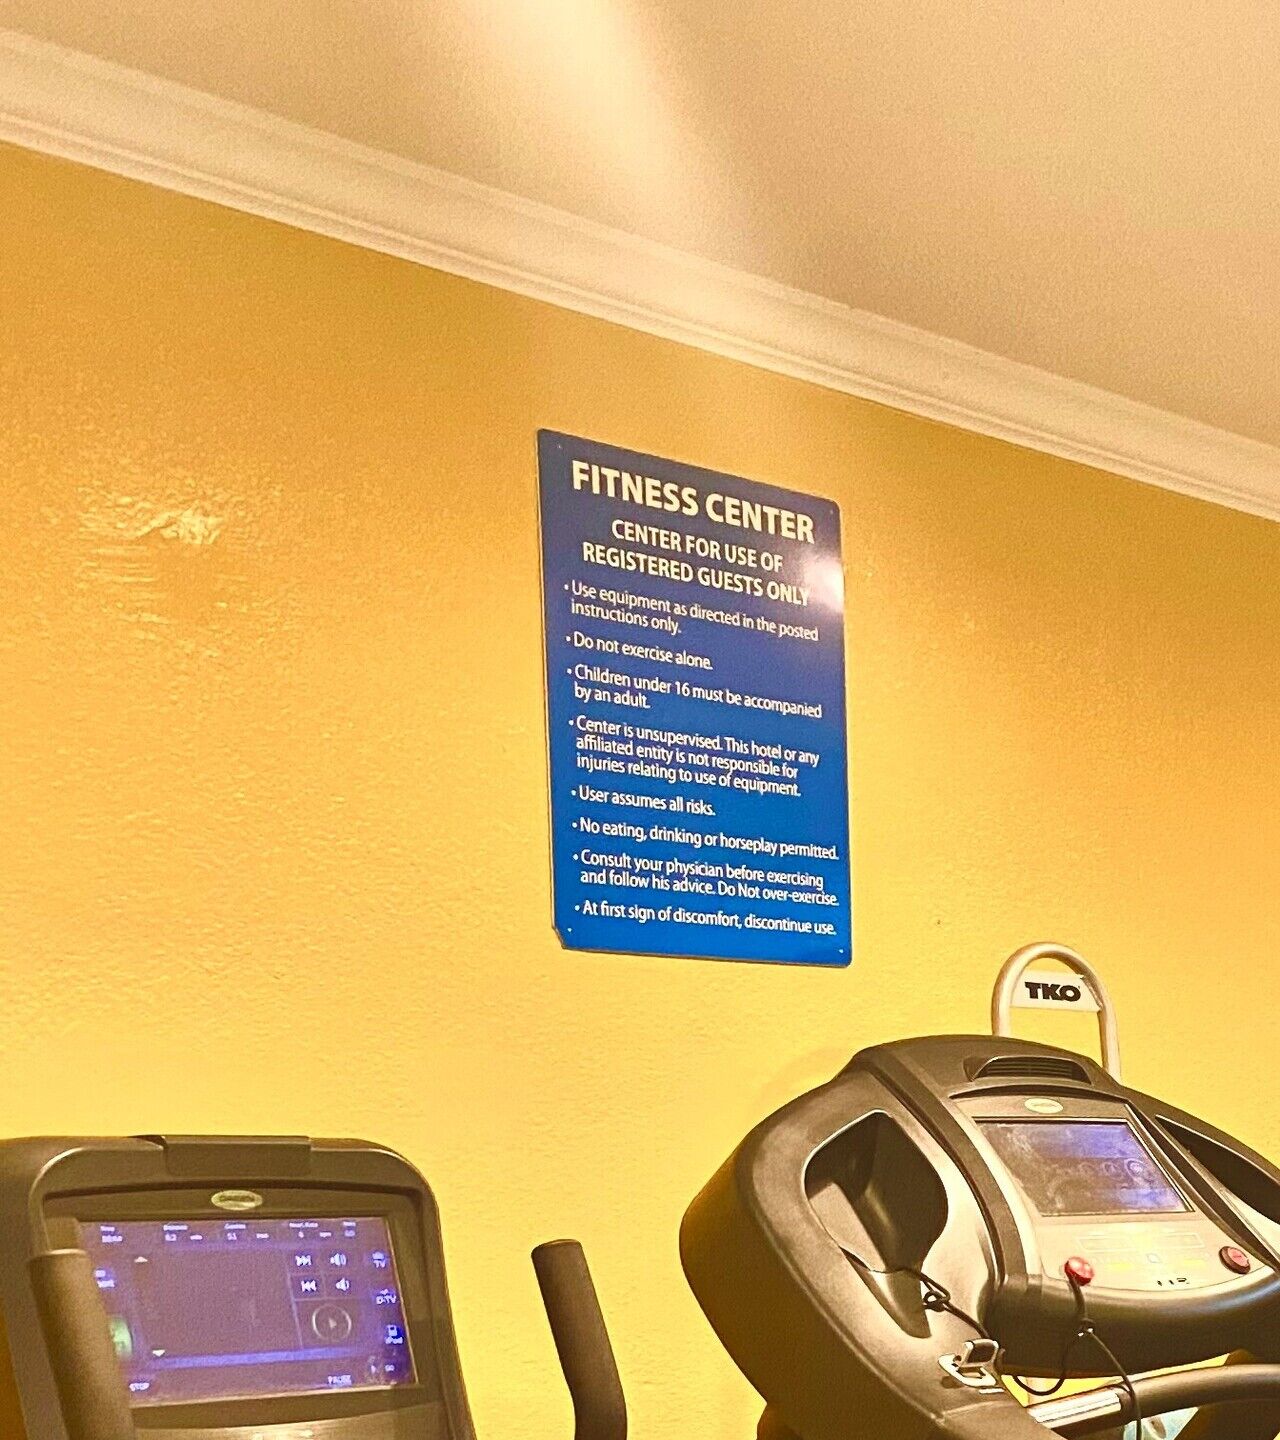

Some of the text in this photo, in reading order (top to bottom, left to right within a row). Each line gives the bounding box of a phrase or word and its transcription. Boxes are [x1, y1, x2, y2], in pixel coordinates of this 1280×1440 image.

[572, 459, 815, 545] FITNESS CENTER
[611, 519, 784, 573] CENTER FOR USE OF
[582, 541, 812, 607] REGISTERED GUESTS ONLY
[571, 579, 819, 641] Use equipment as directed in the posted
[571, 598, 682, 636] instructions only.
[573, 631, 714, 670] Do not exercise alone.
[574, 663, 823, 718] Children under 16 must be accompanied
[574, 681, 652, 709] by an adult.
[576, 714, 820, 768] Center is unsupervised. This hotel or any
[576, 734, 799, 778] affiliated entity is not responsible for
[576, 751, 802, 797] injuries relating to use of equipment.
[579, 784, 717, 816] User assumes all risks.
[579, 816, 840, 860] No eating, drinking or horseplay permitted.
[580, 868, 840, 906] and follow his advice. Do Not over-exercise.
[581, 848, 825, 891] Consult your physician before exercising
[582, 899, 838, 936] At first sign of discomfort, discontinue use.
[1024, 981, 1081, 1002] TKO
